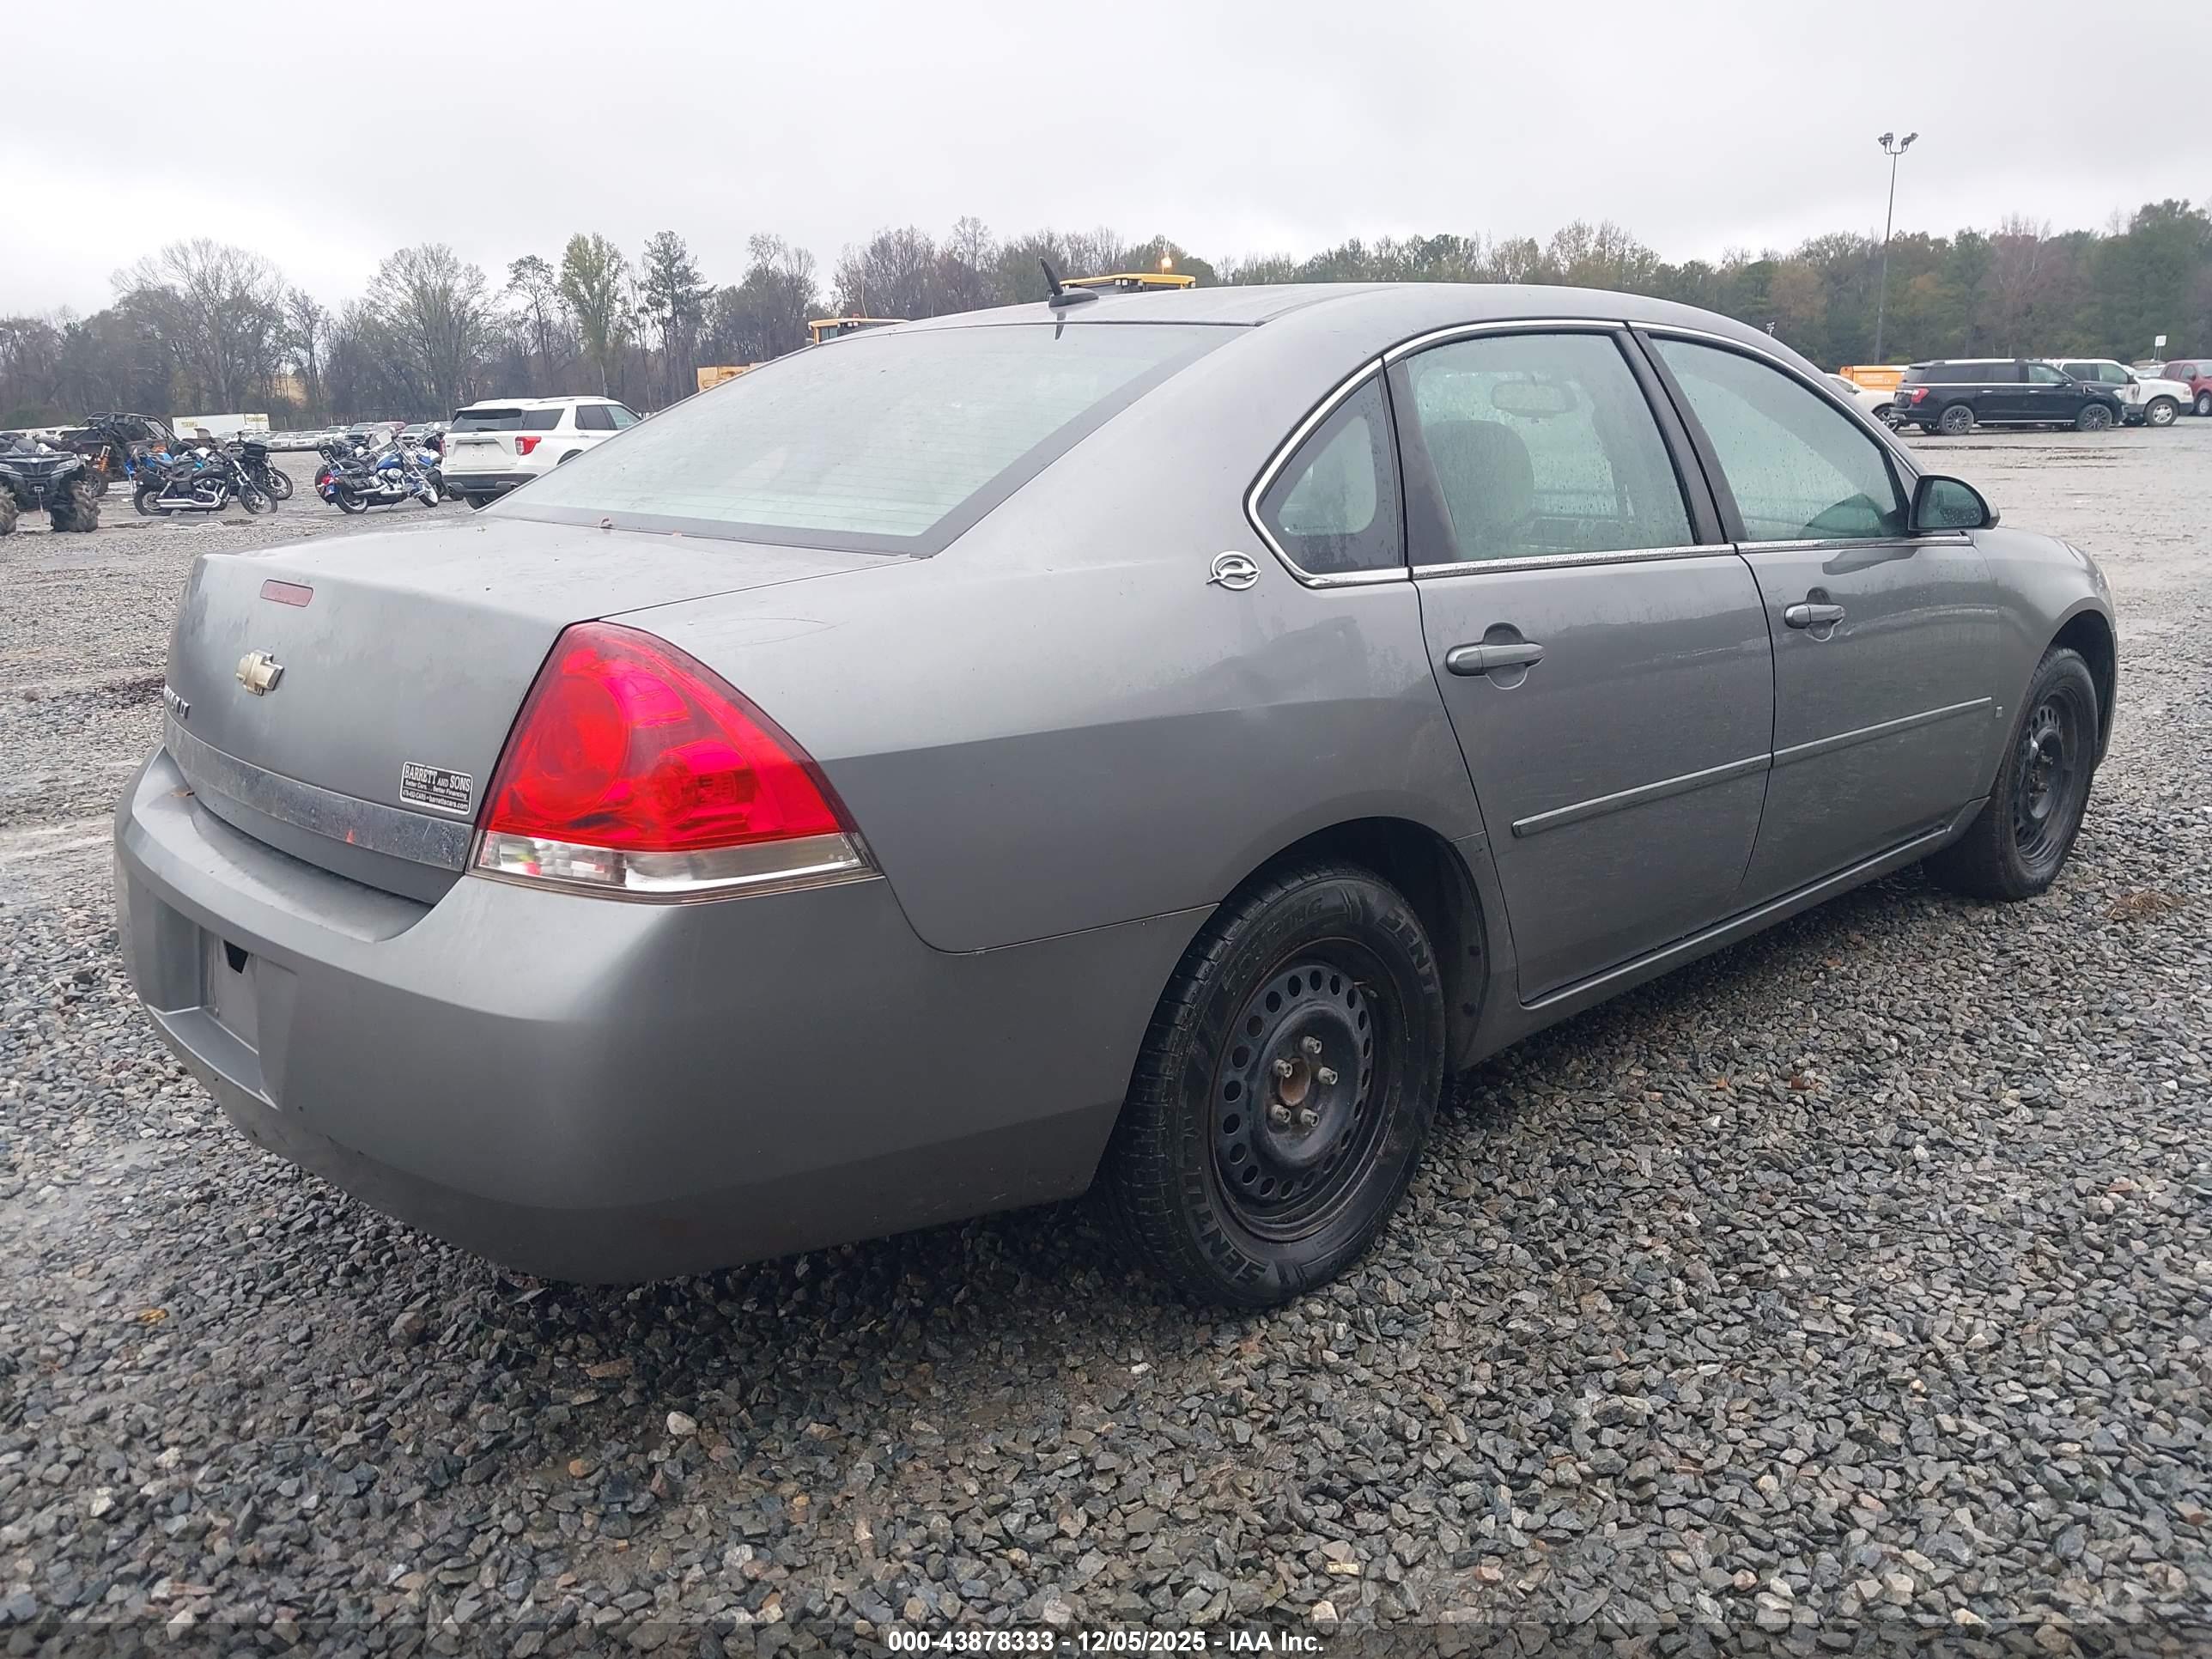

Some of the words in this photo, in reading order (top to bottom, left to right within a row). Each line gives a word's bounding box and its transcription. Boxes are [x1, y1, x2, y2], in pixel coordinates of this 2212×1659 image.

[404, 765, 437, 785] BARRETT
[437, 777, 448, 787] AND
[449, 775, 471, 793] SONS
[404, 779, 417, 787] Better
[433, 785, 447, 793] Better
[447, 788, 467, 799] Financing
